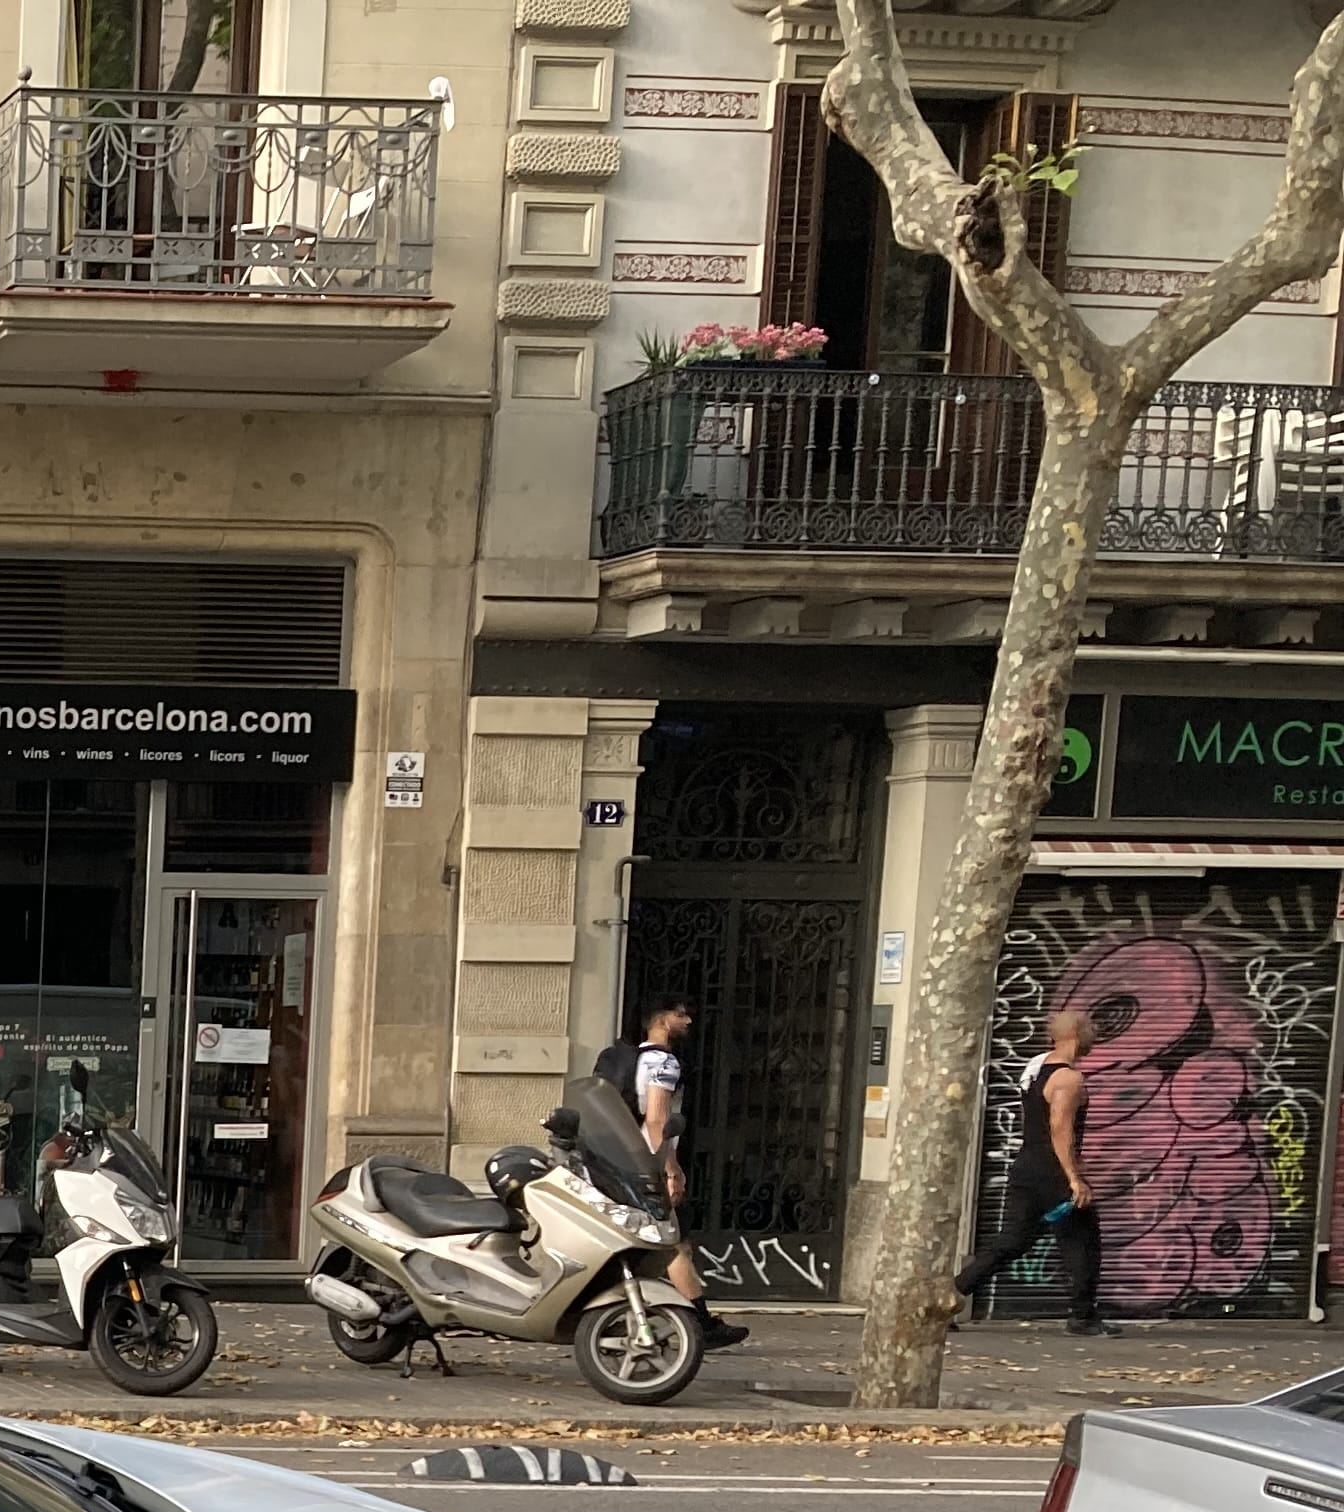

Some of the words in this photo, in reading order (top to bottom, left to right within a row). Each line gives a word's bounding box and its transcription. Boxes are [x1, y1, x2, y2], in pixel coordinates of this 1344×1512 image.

[22, 747, 50, 759] vins
[76, 747, 113, 760] wines
[139, 748, 183, 762] licores
[210, 749, 245, 763] licors
[272, 751, 310, 765] liquor
[593, 803, 617, 823] 12
[66, 1043, 78, 1051] de
[105, 1044, 129, 1052] Papa
